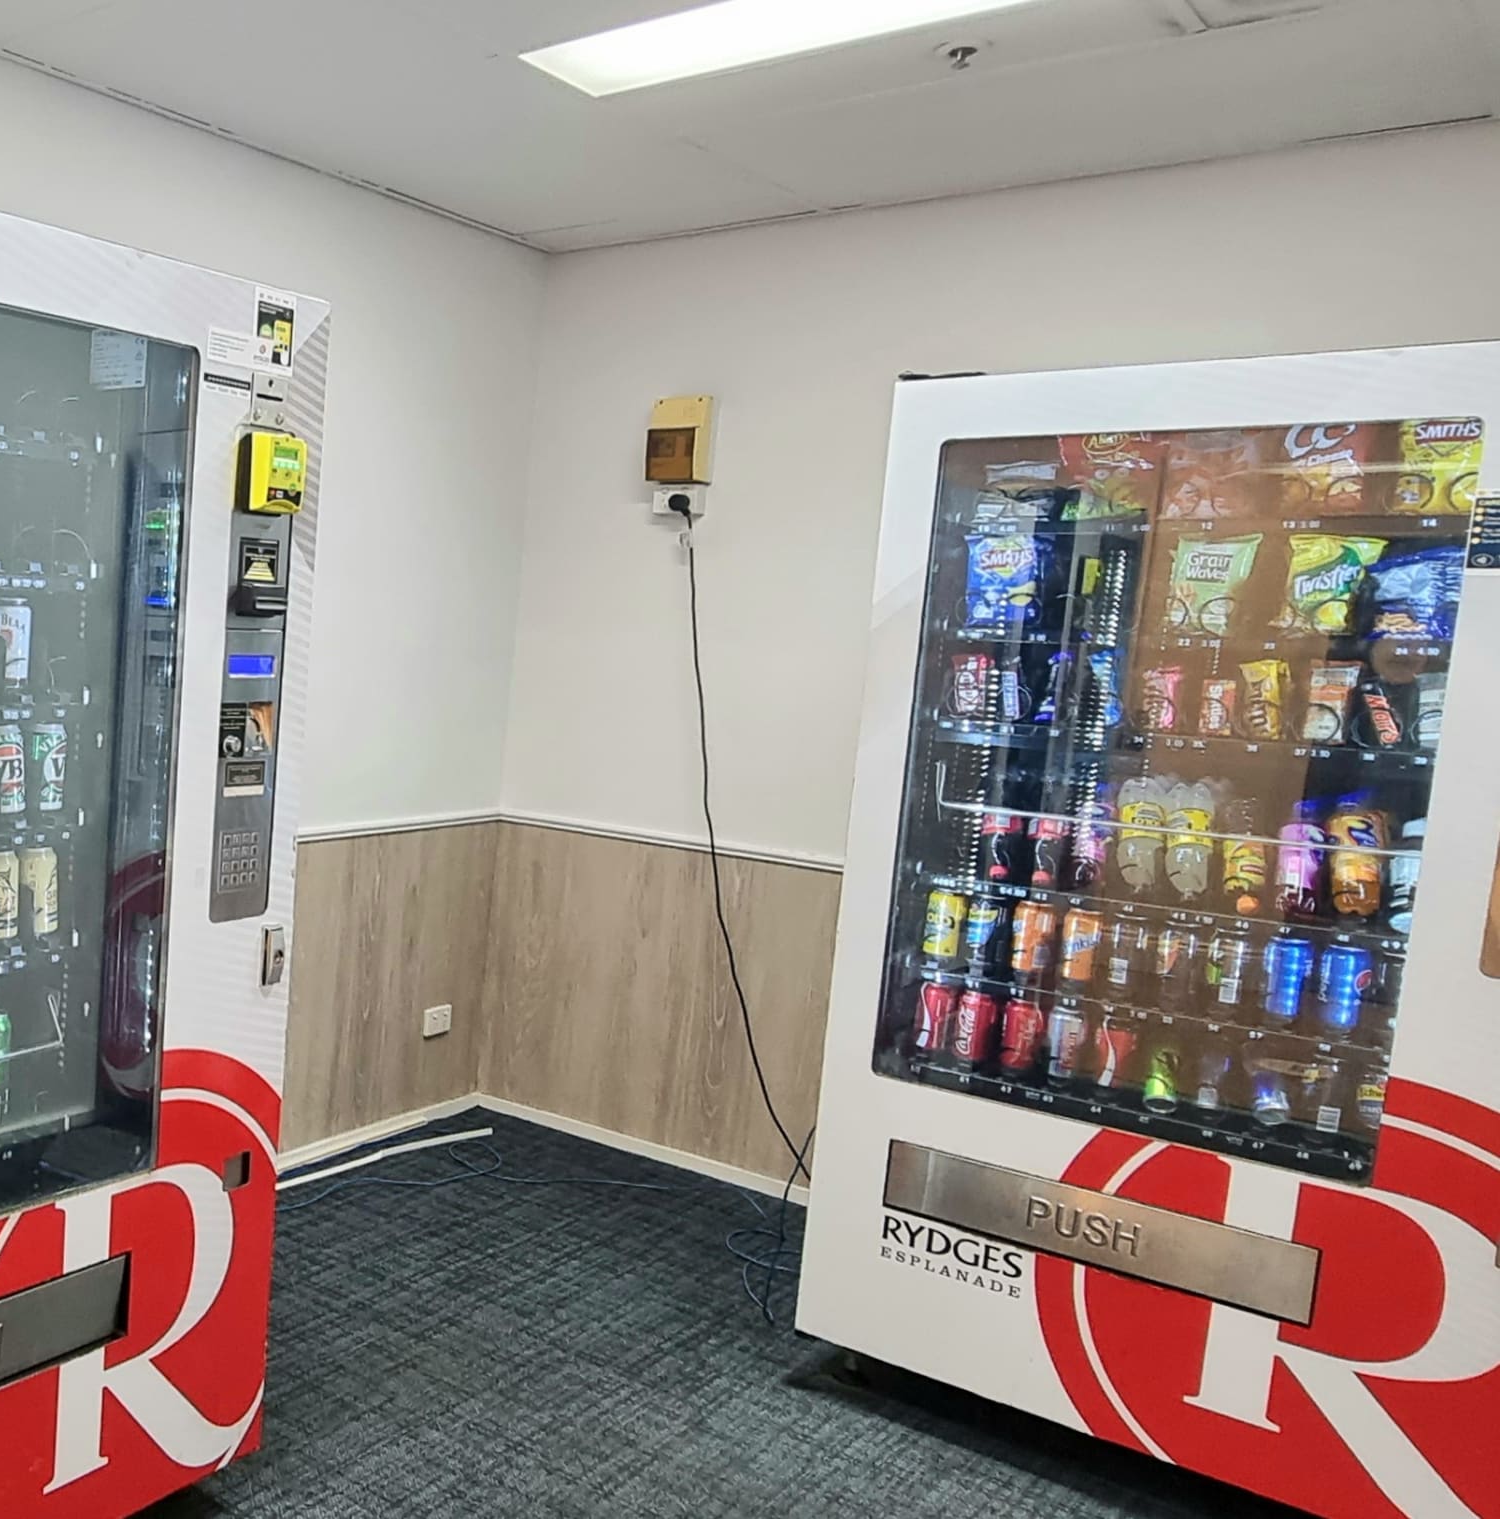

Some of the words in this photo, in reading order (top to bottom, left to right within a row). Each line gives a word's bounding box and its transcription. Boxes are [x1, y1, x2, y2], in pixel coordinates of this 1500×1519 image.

[1187, 552, 1232, 568] Grain
[882, 1214, 1024, 1279] RYDGES
[1025, 1197, 1142, 1257] PUSH
[880, 1245, 1022, 1299] ESPLANADE
